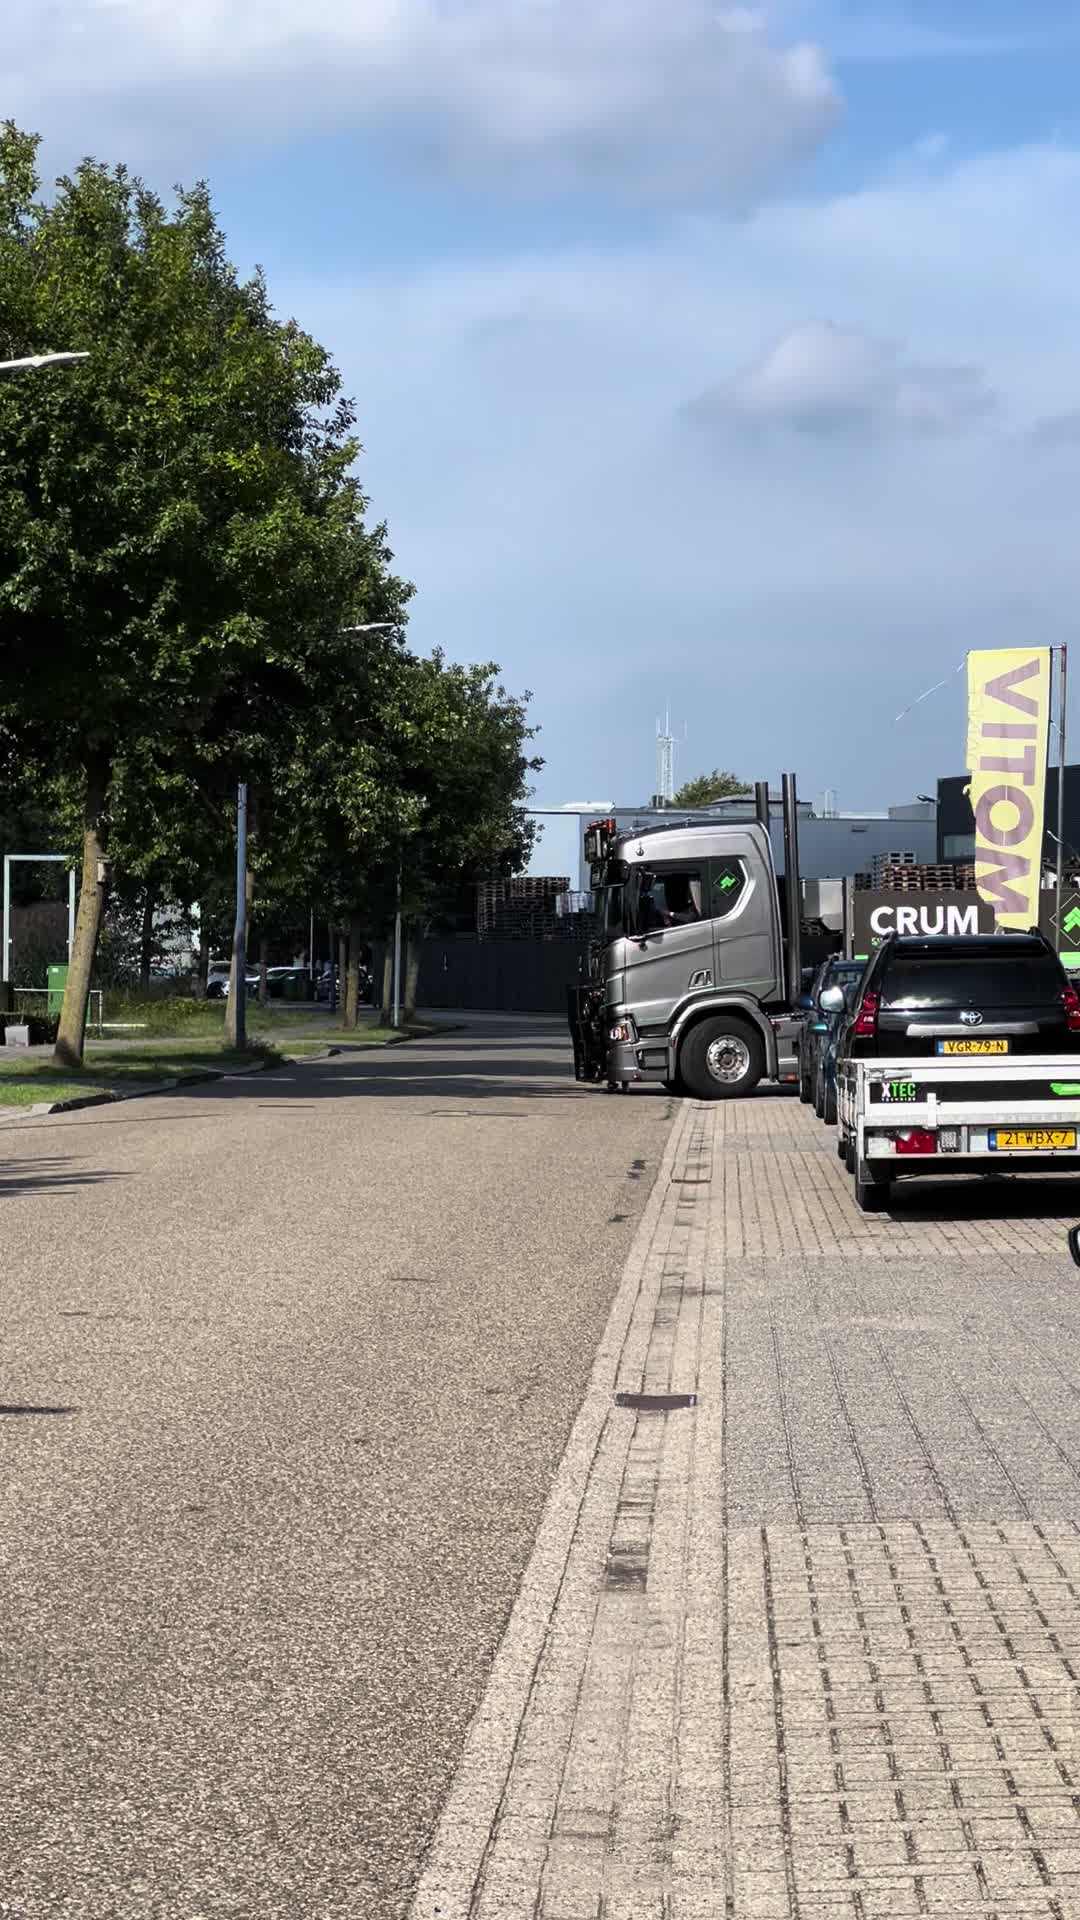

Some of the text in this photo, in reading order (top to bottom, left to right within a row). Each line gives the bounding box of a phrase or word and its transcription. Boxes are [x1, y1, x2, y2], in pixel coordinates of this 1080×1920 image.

[974, 657, 1041, 914] VITOM
[870, 905, 979, 936] CRUM
[947, 1040, 1005, 1052] VGR-79-N
[881, 1082, 916, 1098] XTEC
[1004, 1130, 1068, 1145] 21-WBX-7
